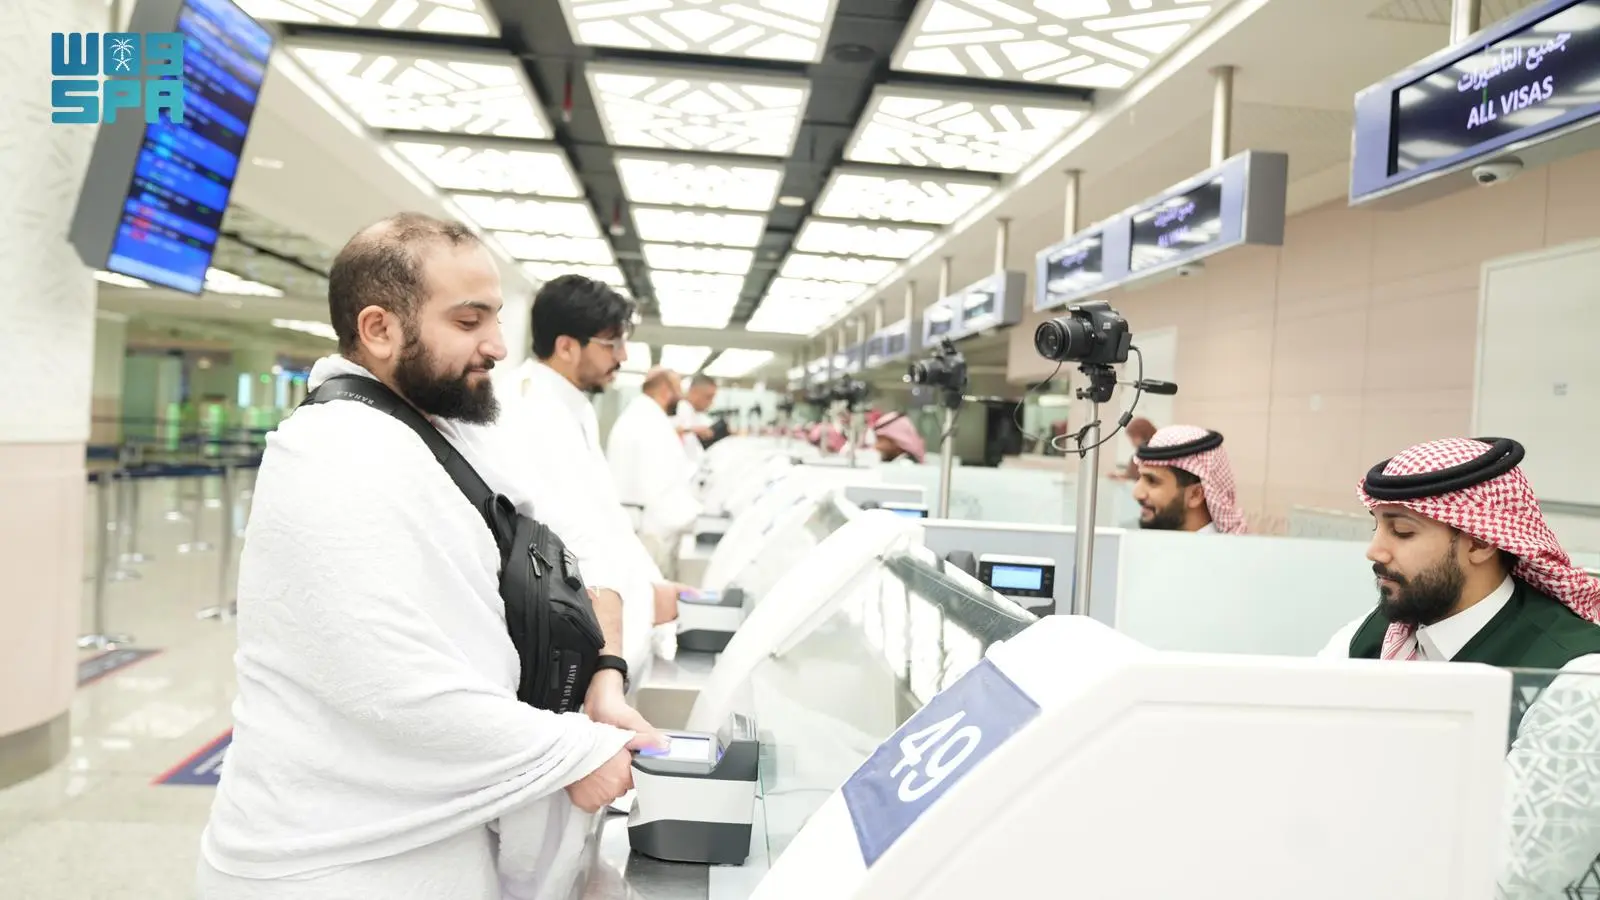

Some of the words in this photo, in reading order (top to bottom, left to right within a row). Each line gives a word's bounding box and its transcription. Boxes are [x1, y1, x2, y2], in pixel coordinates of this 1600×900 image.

[1466, 100, 1497, 130] ALL
[1500, 75, 1553, 115] VISAS
[889, 710, 982, 802] 49
